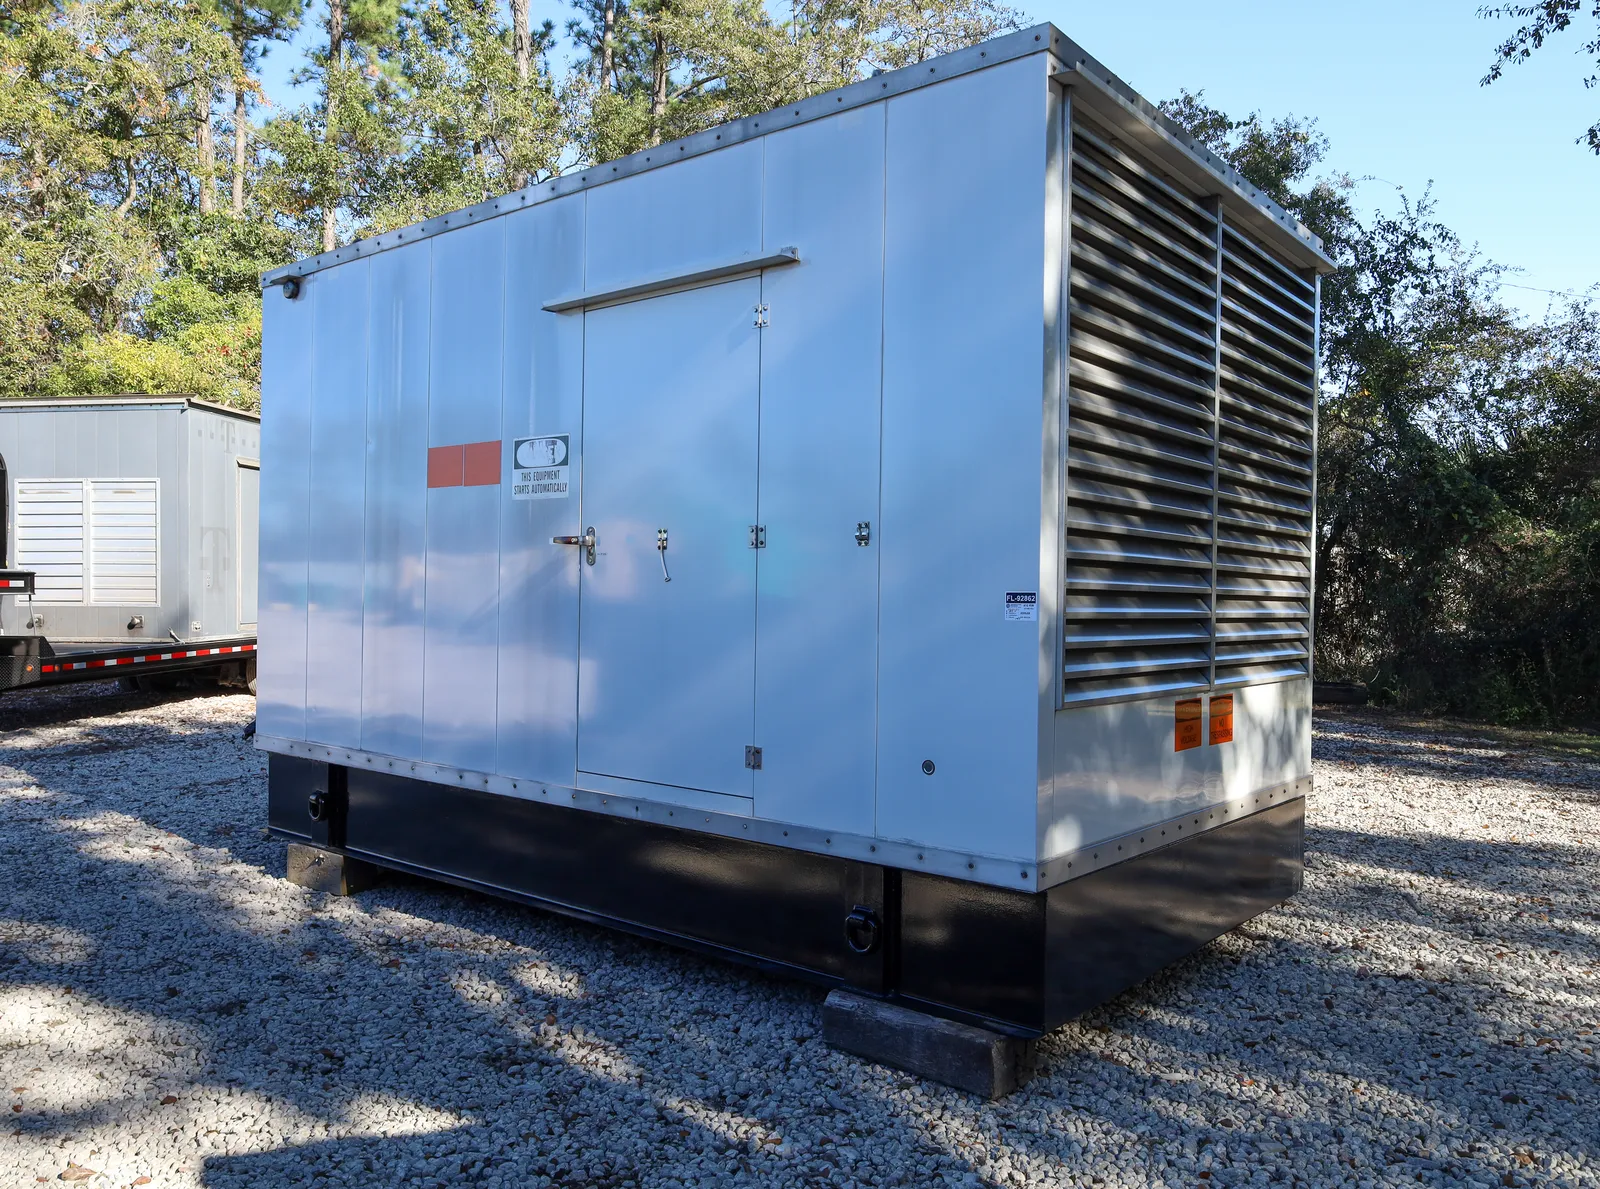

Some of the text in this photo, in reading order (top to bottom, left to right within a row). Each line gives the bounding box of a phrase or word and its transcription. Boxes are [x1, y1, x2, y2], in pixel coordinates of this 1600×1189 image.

[521, 470, 560, 482] THIS EQUIPMENT
[513, 482, 568, 495] STARTS AUTOMATICALLY
